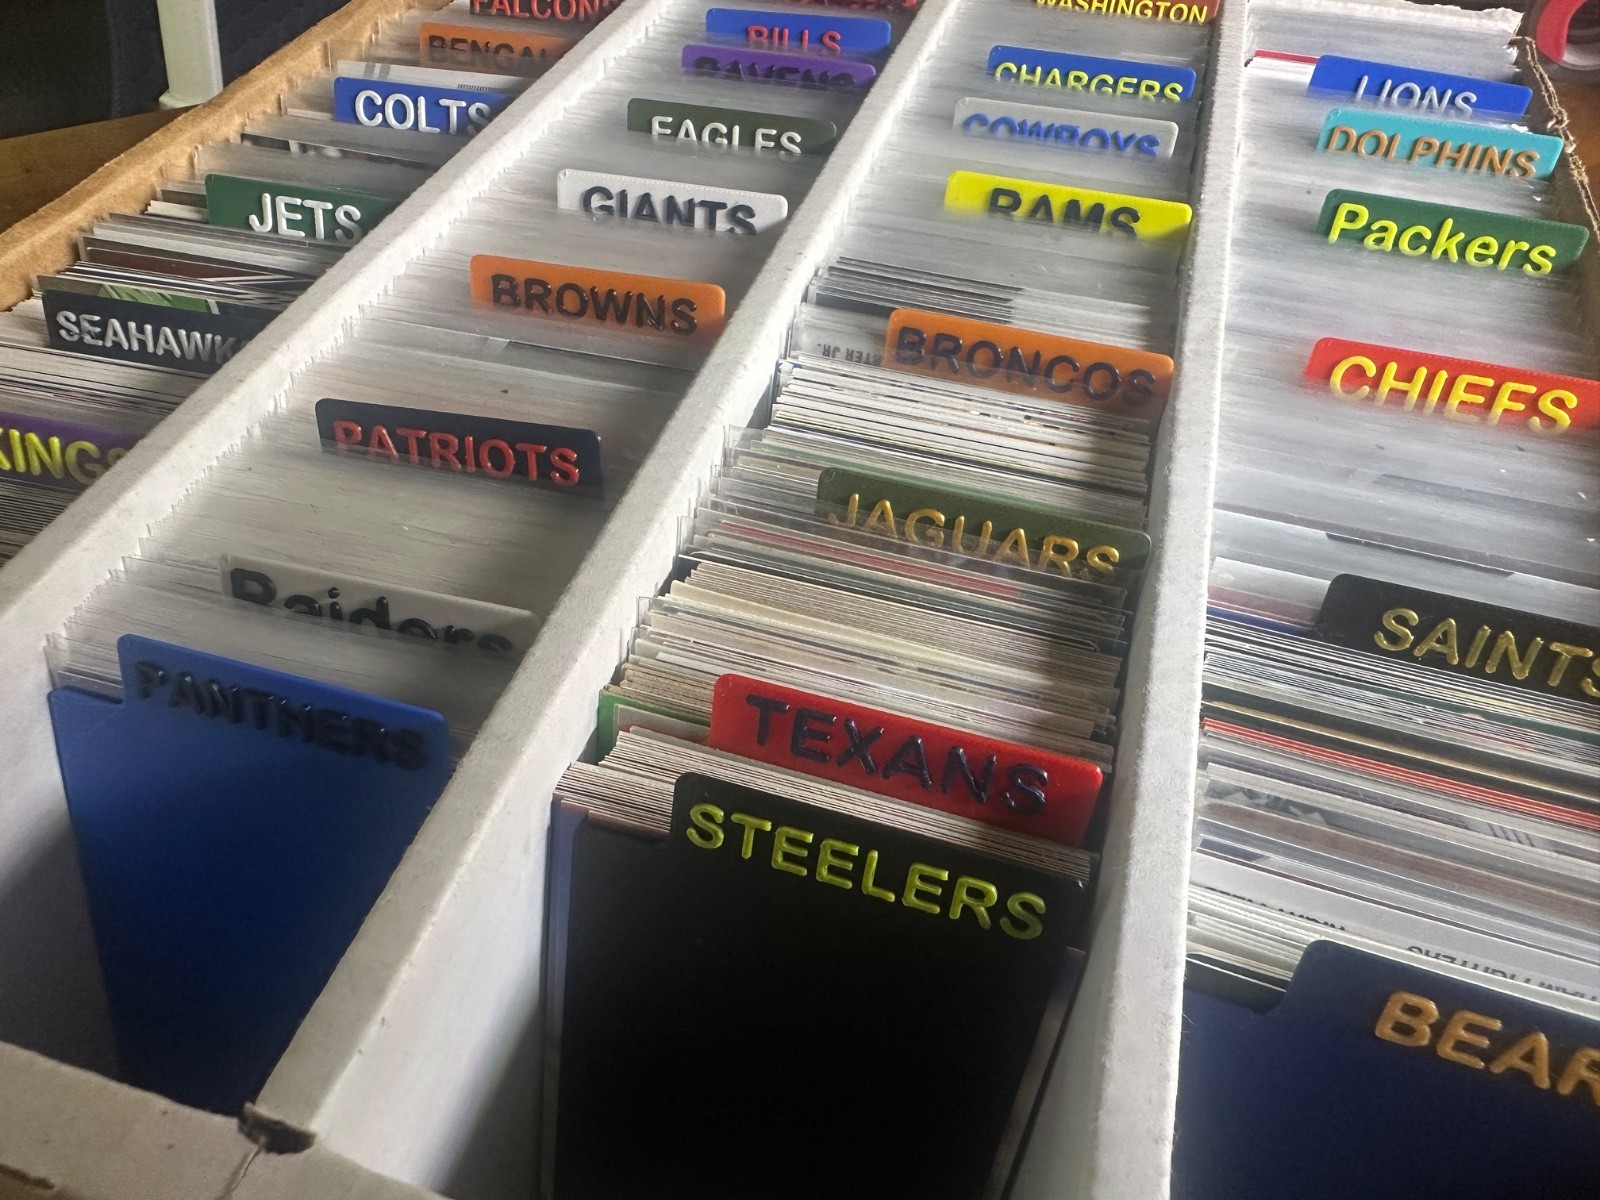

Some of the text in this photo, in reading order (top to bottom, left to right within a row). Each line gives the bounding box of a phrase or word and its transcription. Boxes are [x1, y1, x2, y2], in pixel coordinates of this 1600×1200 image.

[354, 90, 493, 137] COLTS
[994, 62, 1184, 103] CHARGERS
[651, 116, 802, 154] EAGLES
[1326, 125, 1541, 179] DOLPHINS
[249, 193, 364, 242] JETS
[582, 186, 757, 235] GIANTS
[990, 188, 1141, 237] RAMS
[1327, 203, 1557, 277] Packers
[491, 274, 699, 336] BROWNS
[56, 311, 247, 365] SEAHAWK
[896, 326, 1157, 407] BRONCOS
[1329, 355, 1579, 436] CHIEFS
[333, 420, 581, 487] PATRIOTS
[828, 492, 1121, 584] JAGUARS
[134, 661, 429, 770] PANTHERS
[746, 694, 1049, 814] TEXANS
[686, 803, 1047, 940] STEELERS
[1374, 990, 1600, 1106] BEAR
